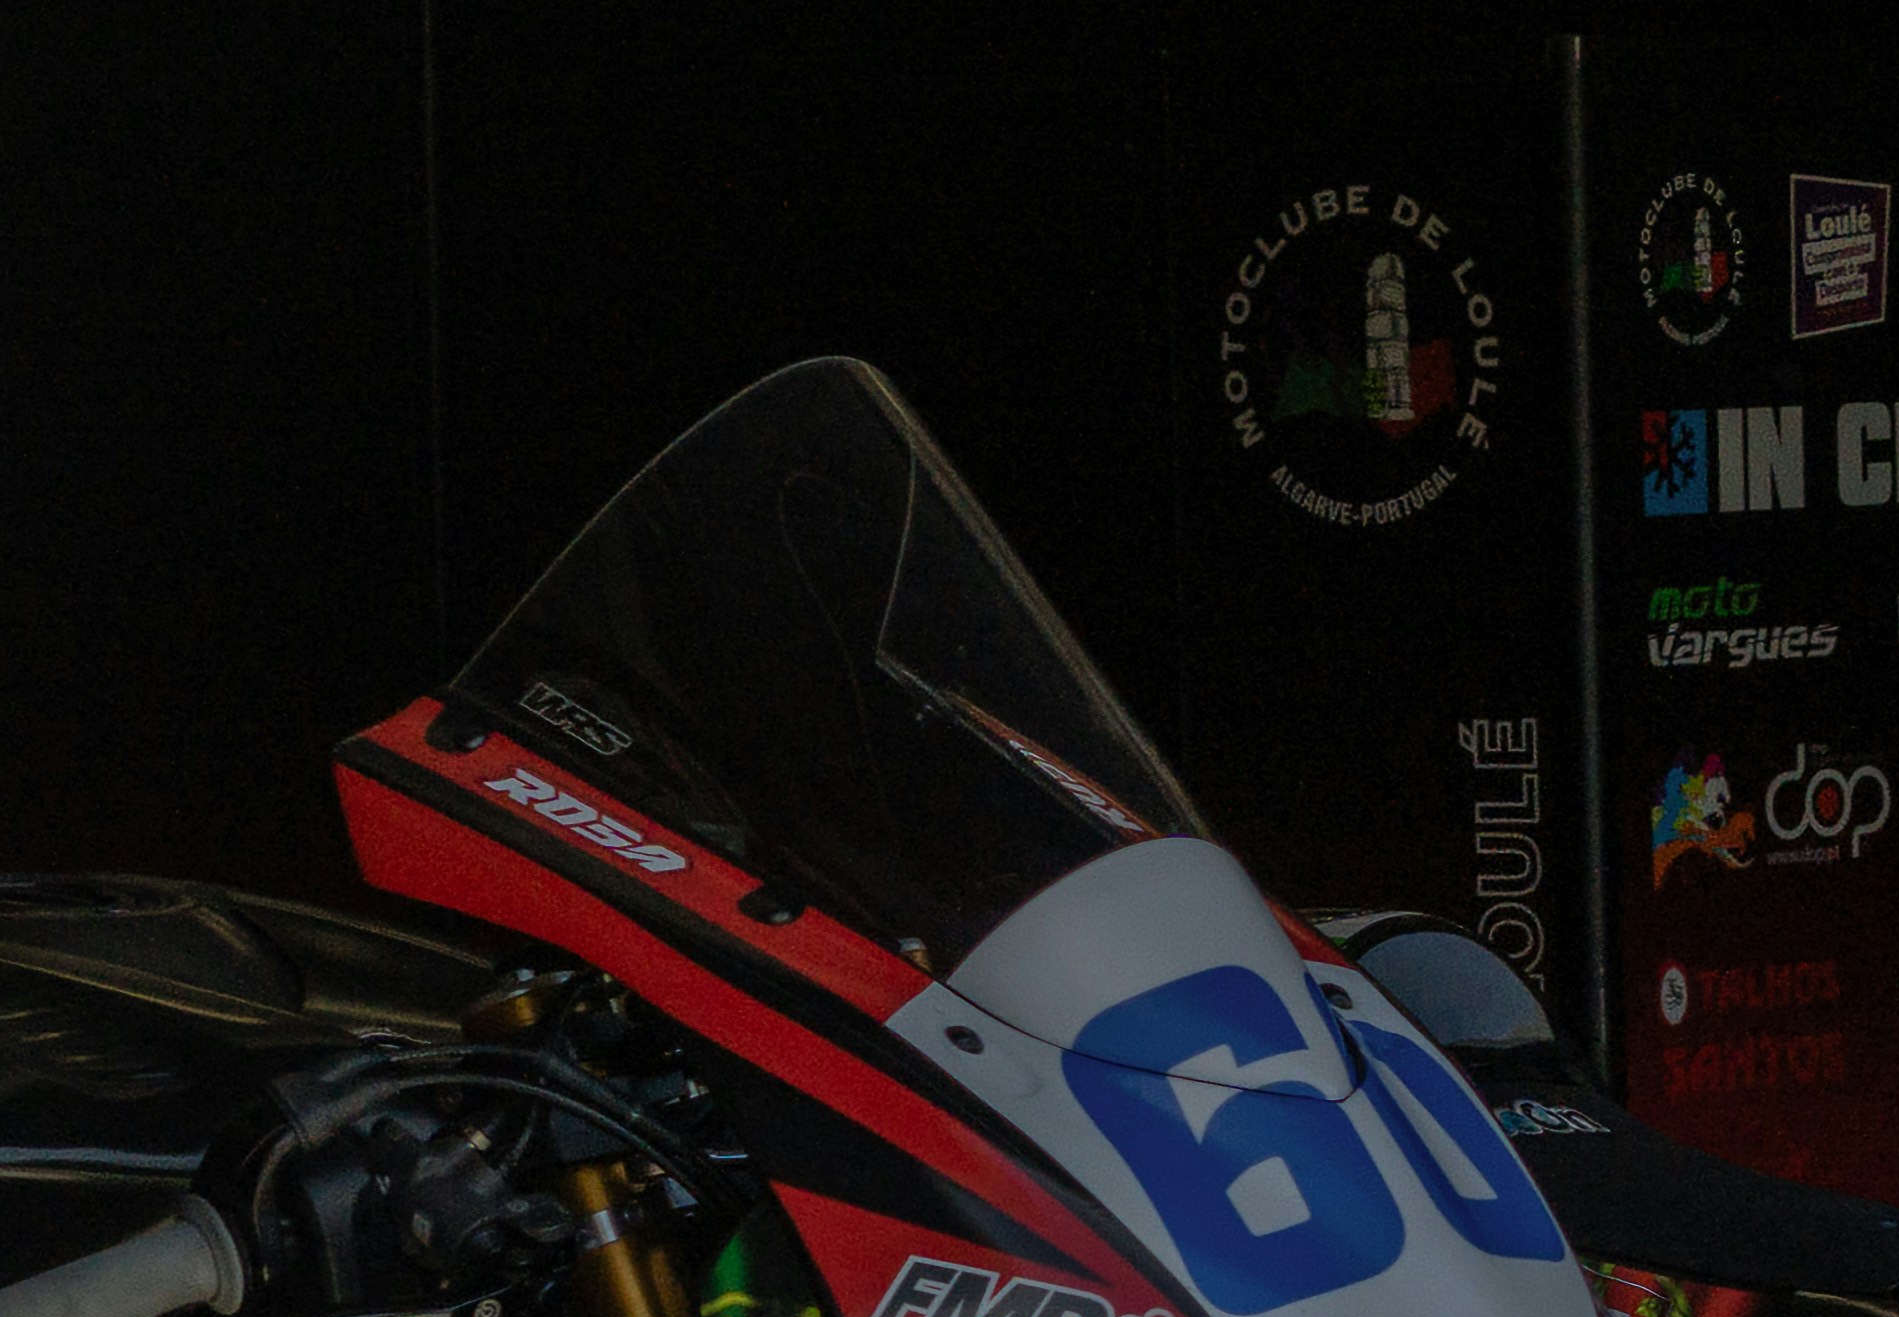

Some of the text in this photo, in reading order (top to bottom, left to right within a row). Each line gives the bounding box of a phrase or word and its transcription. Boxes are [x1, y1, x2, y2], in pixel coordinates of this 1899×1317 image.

[1805, 203, 1872, 240] Loulé
[1221, 184, 1372, 450] MOTOCLUBE
[1390, 193, 1451, 252] DE
[1267, 463, 1459, 528] ALGARVE-PORTUGAL
[1717, 405, 1806, 513] IN
[1648, 576, 1761, 622] moto
[484, 767, 688, 873] ROSA
[1457, 717, 1546, 990] OULÉ
[1764, 742, 1892, 860] dop
[1061, 965, 1566, 1316] 60
